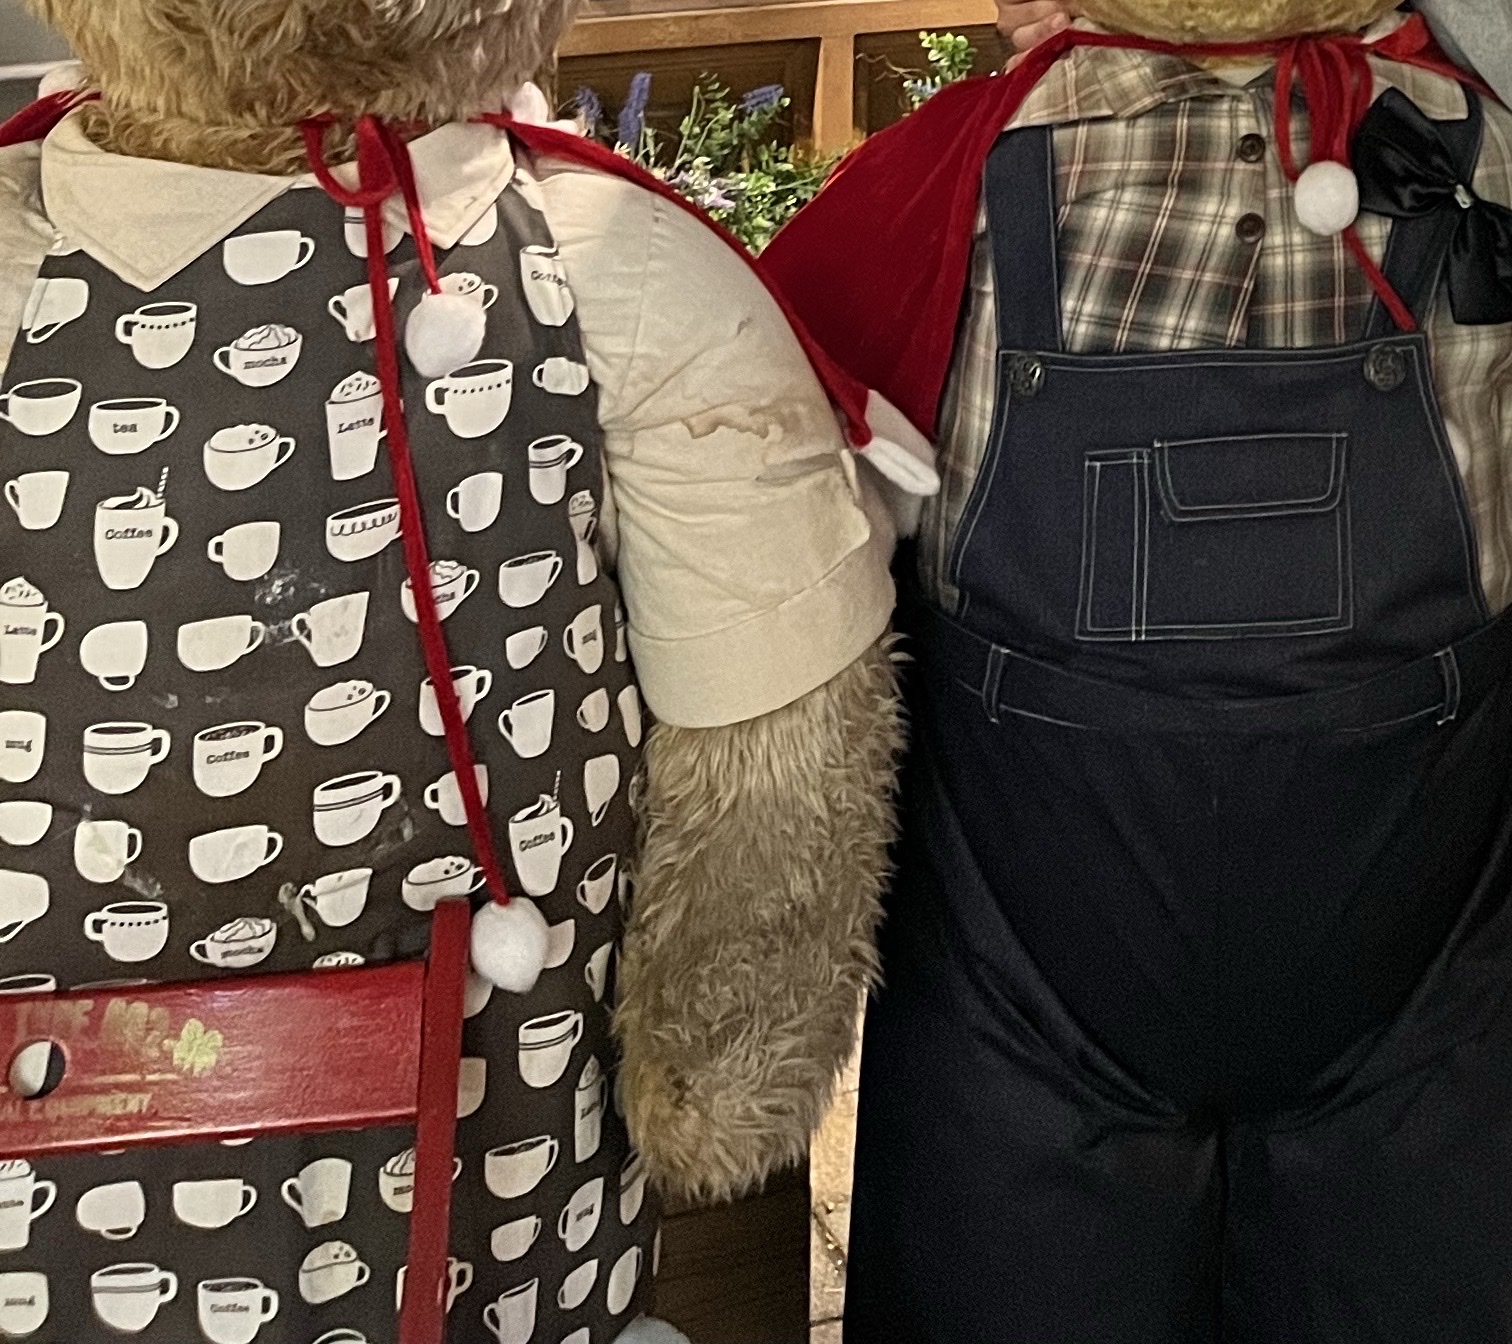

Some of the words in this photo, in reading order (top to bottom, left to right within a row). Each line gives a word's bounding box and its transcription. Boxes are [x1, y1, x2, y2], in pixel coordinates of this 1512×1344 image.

[243, 355, 287, 370] mocha
[112, 422, 138, 434] tea
[337, 417, 375, 434] Latte
[105, 527, 153, 540] Coffee
[206, 750, 251, 765] Coffee
[518, 830, 556, 853] Coffee
